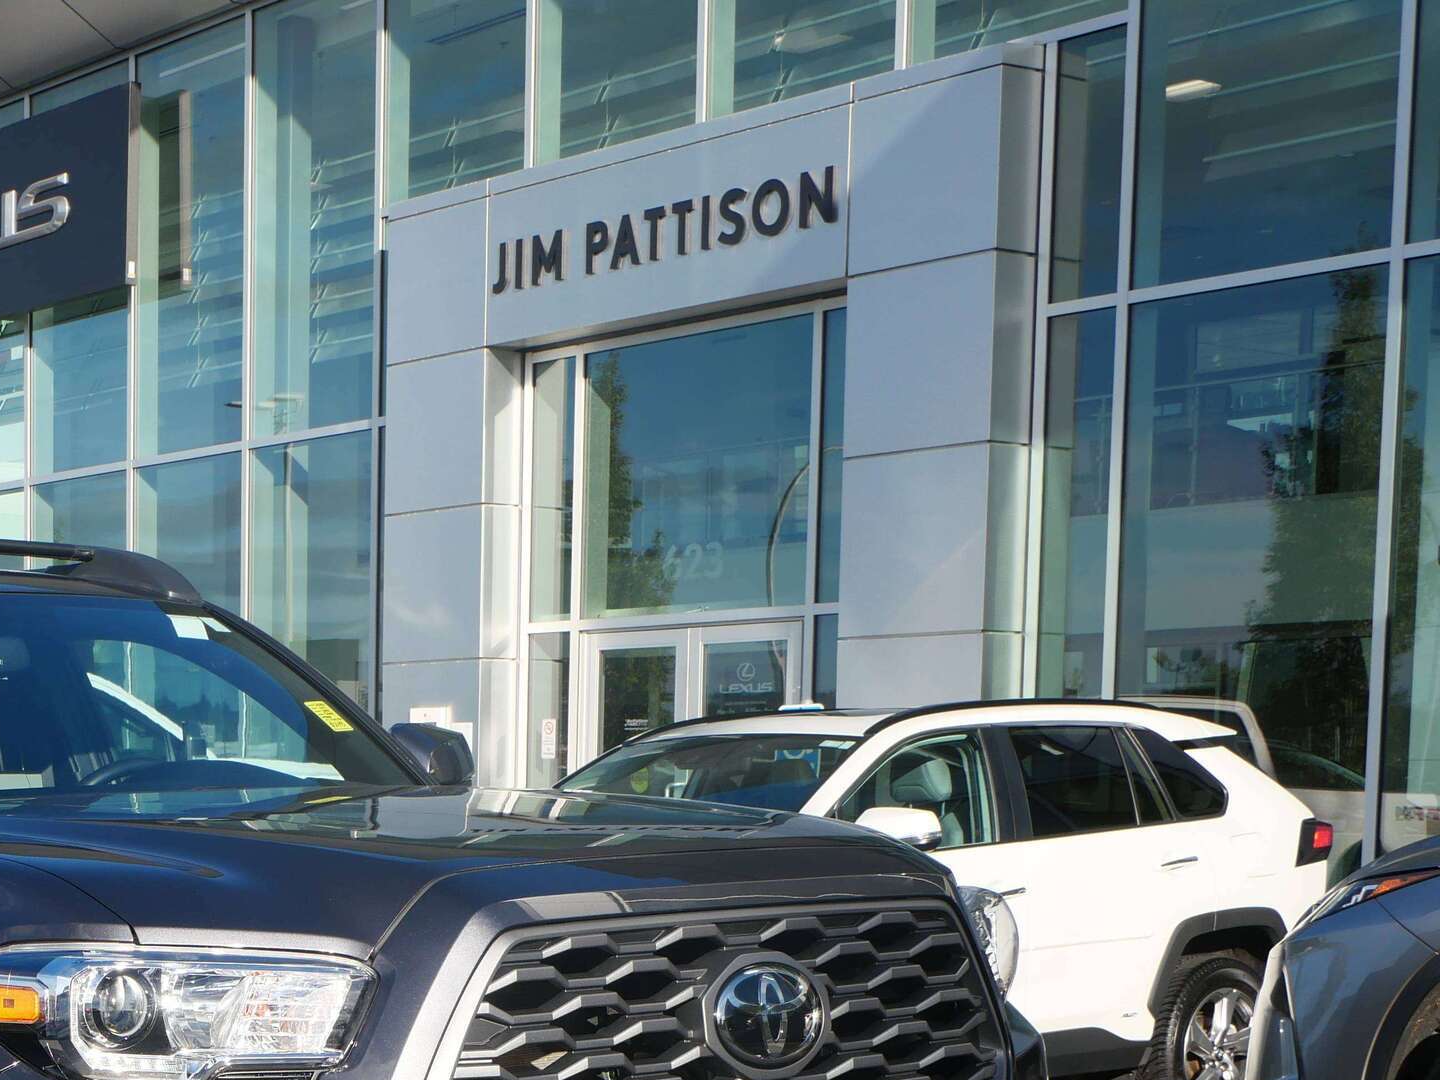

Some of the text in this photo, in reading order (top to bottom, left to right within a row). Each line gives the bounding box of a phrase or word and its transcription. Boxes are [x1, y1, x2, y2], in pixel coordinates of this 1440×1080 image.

[492, 165, 840, 295] JIM PATTISON
[662, 541, 723, 580] 623
[719, 681, 774, 694] LEXUS
